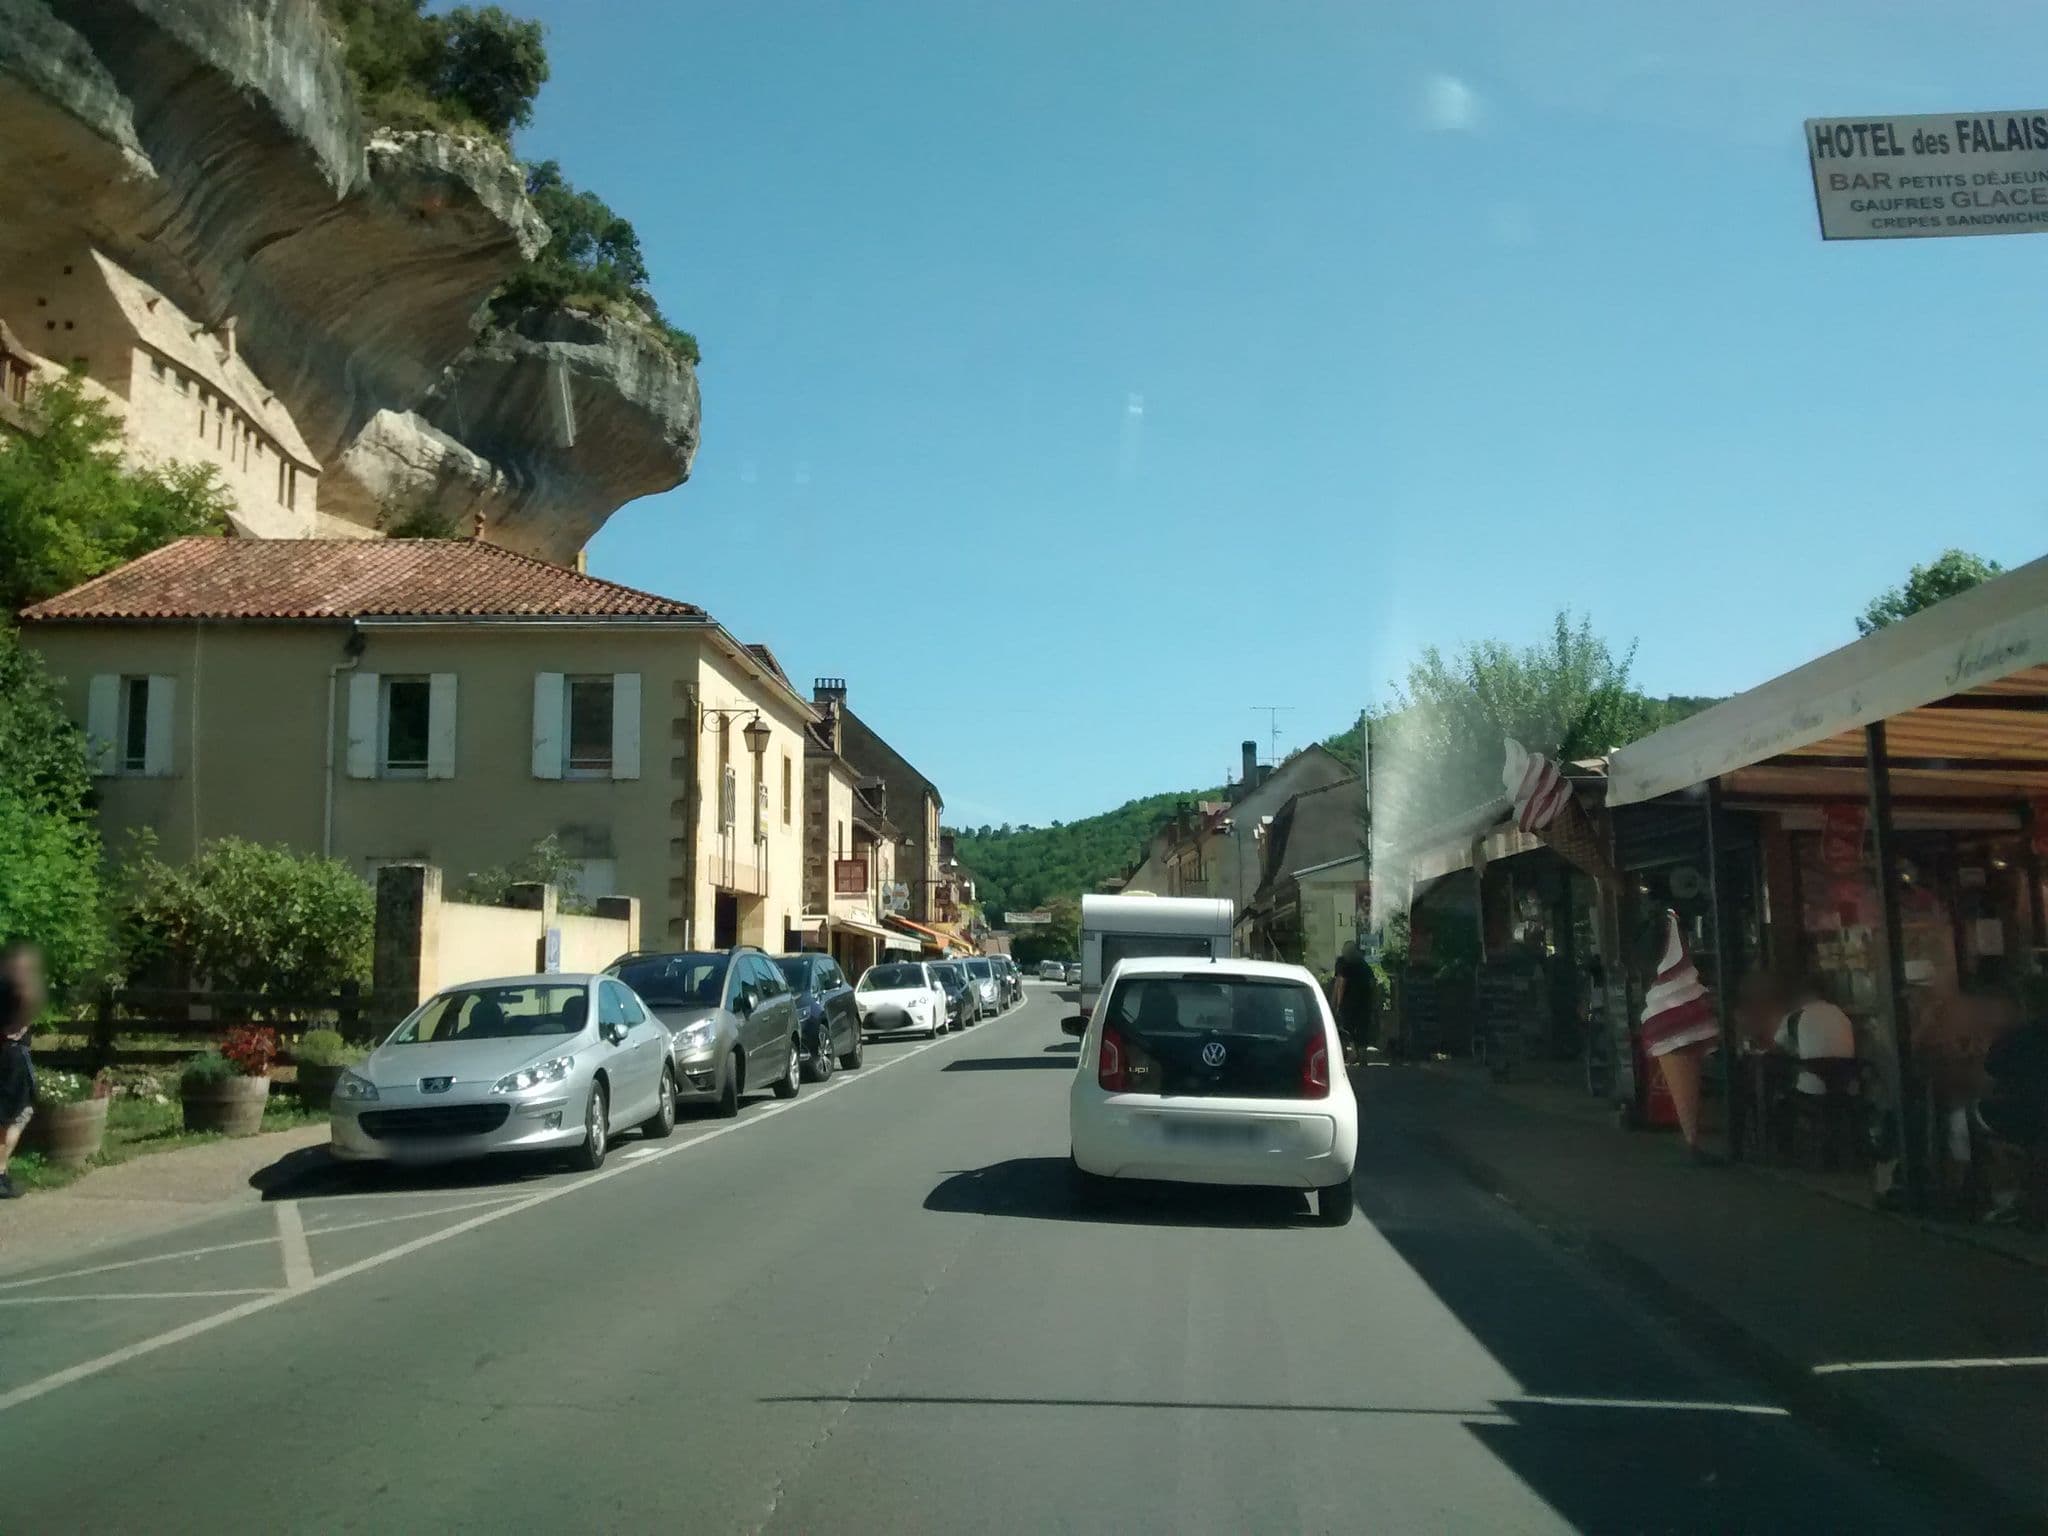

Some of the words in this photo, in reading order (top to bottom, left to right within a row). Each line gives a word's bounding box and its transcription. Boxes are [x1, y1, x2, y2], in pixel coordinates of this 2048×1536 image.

[1815, 123, 1905, 158] HOTEL
[1911, 128, 1950, 155] des
[1829, 172, 1893, 191] BAR
[1899, 174, 1967, 189] PETITS
[1850, 196, 1945, 213] GAUFRES
[1951, 187, 2048, 209] GLACE
